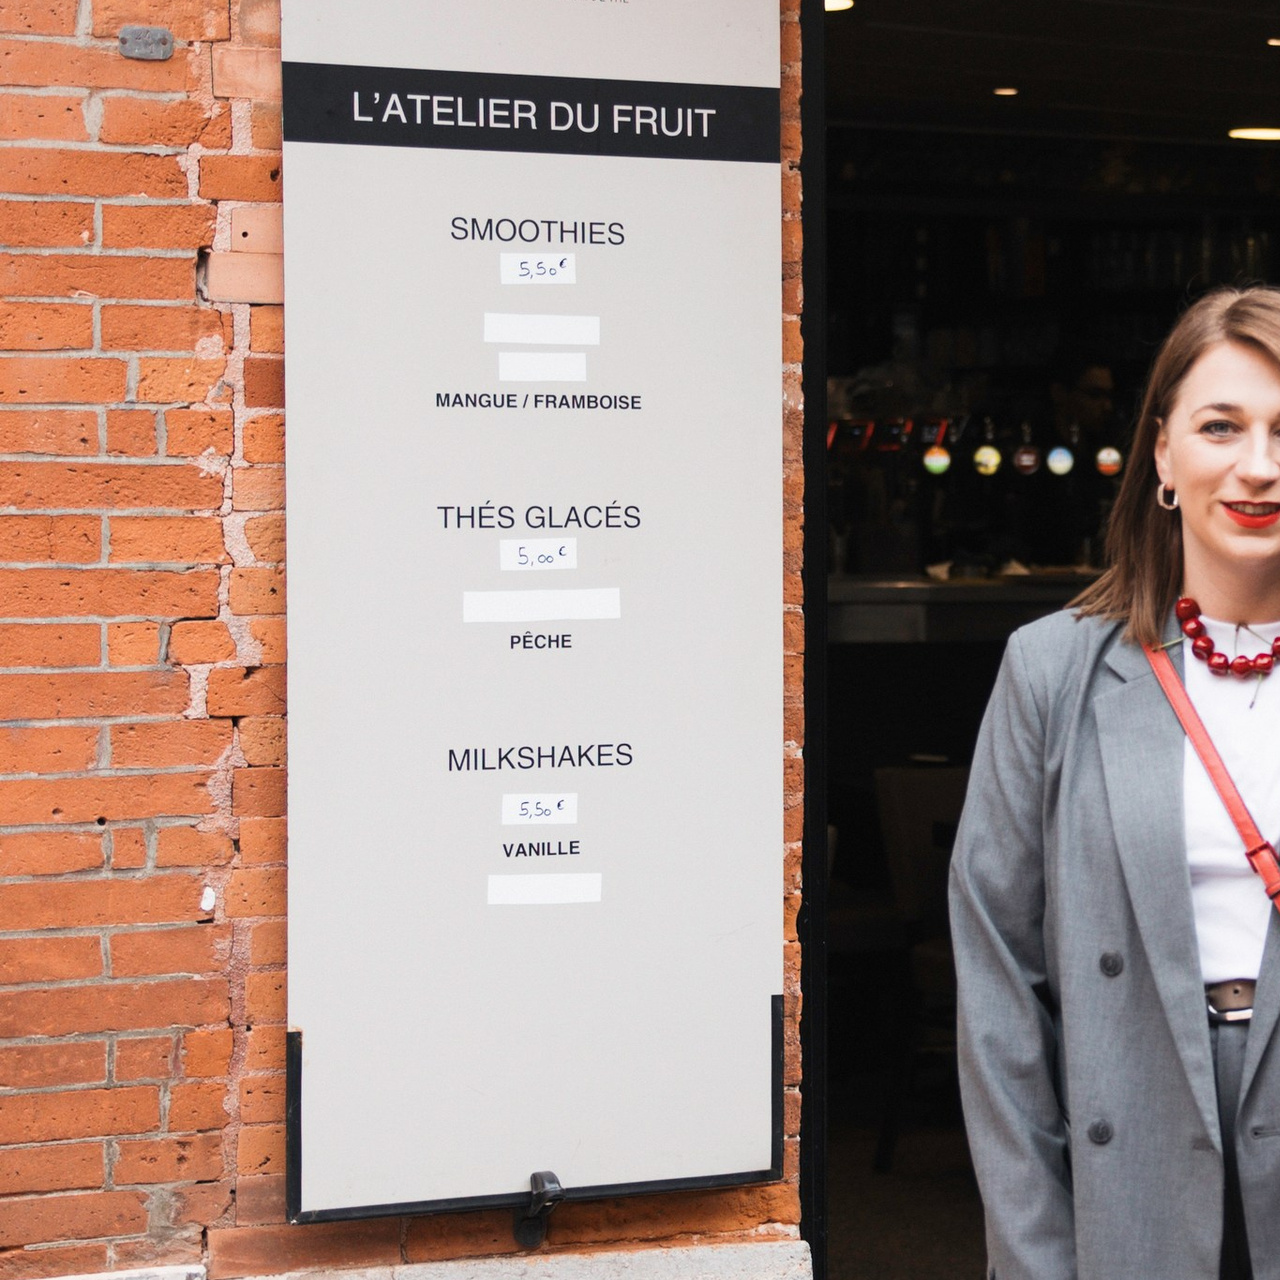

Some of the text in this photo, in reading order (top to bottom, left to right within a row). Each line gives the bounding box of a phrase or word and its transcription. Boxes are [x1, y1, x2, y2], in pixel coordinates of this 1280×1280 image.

[353, 91, 716, 138] L'ATELIER DU FRUIT
[450, 216, 626, 247] SMOOTHIES
[435, 392, 642, 411] MANGUE / FRAMBOISE
[437, 499, 641, 531] THÉS GLACÉS
[509, 630, 572, 651] PÊCHE
[447, 742, 634, 773] MILKSHAKES
[502, 840, 581, 858] VANILLE
